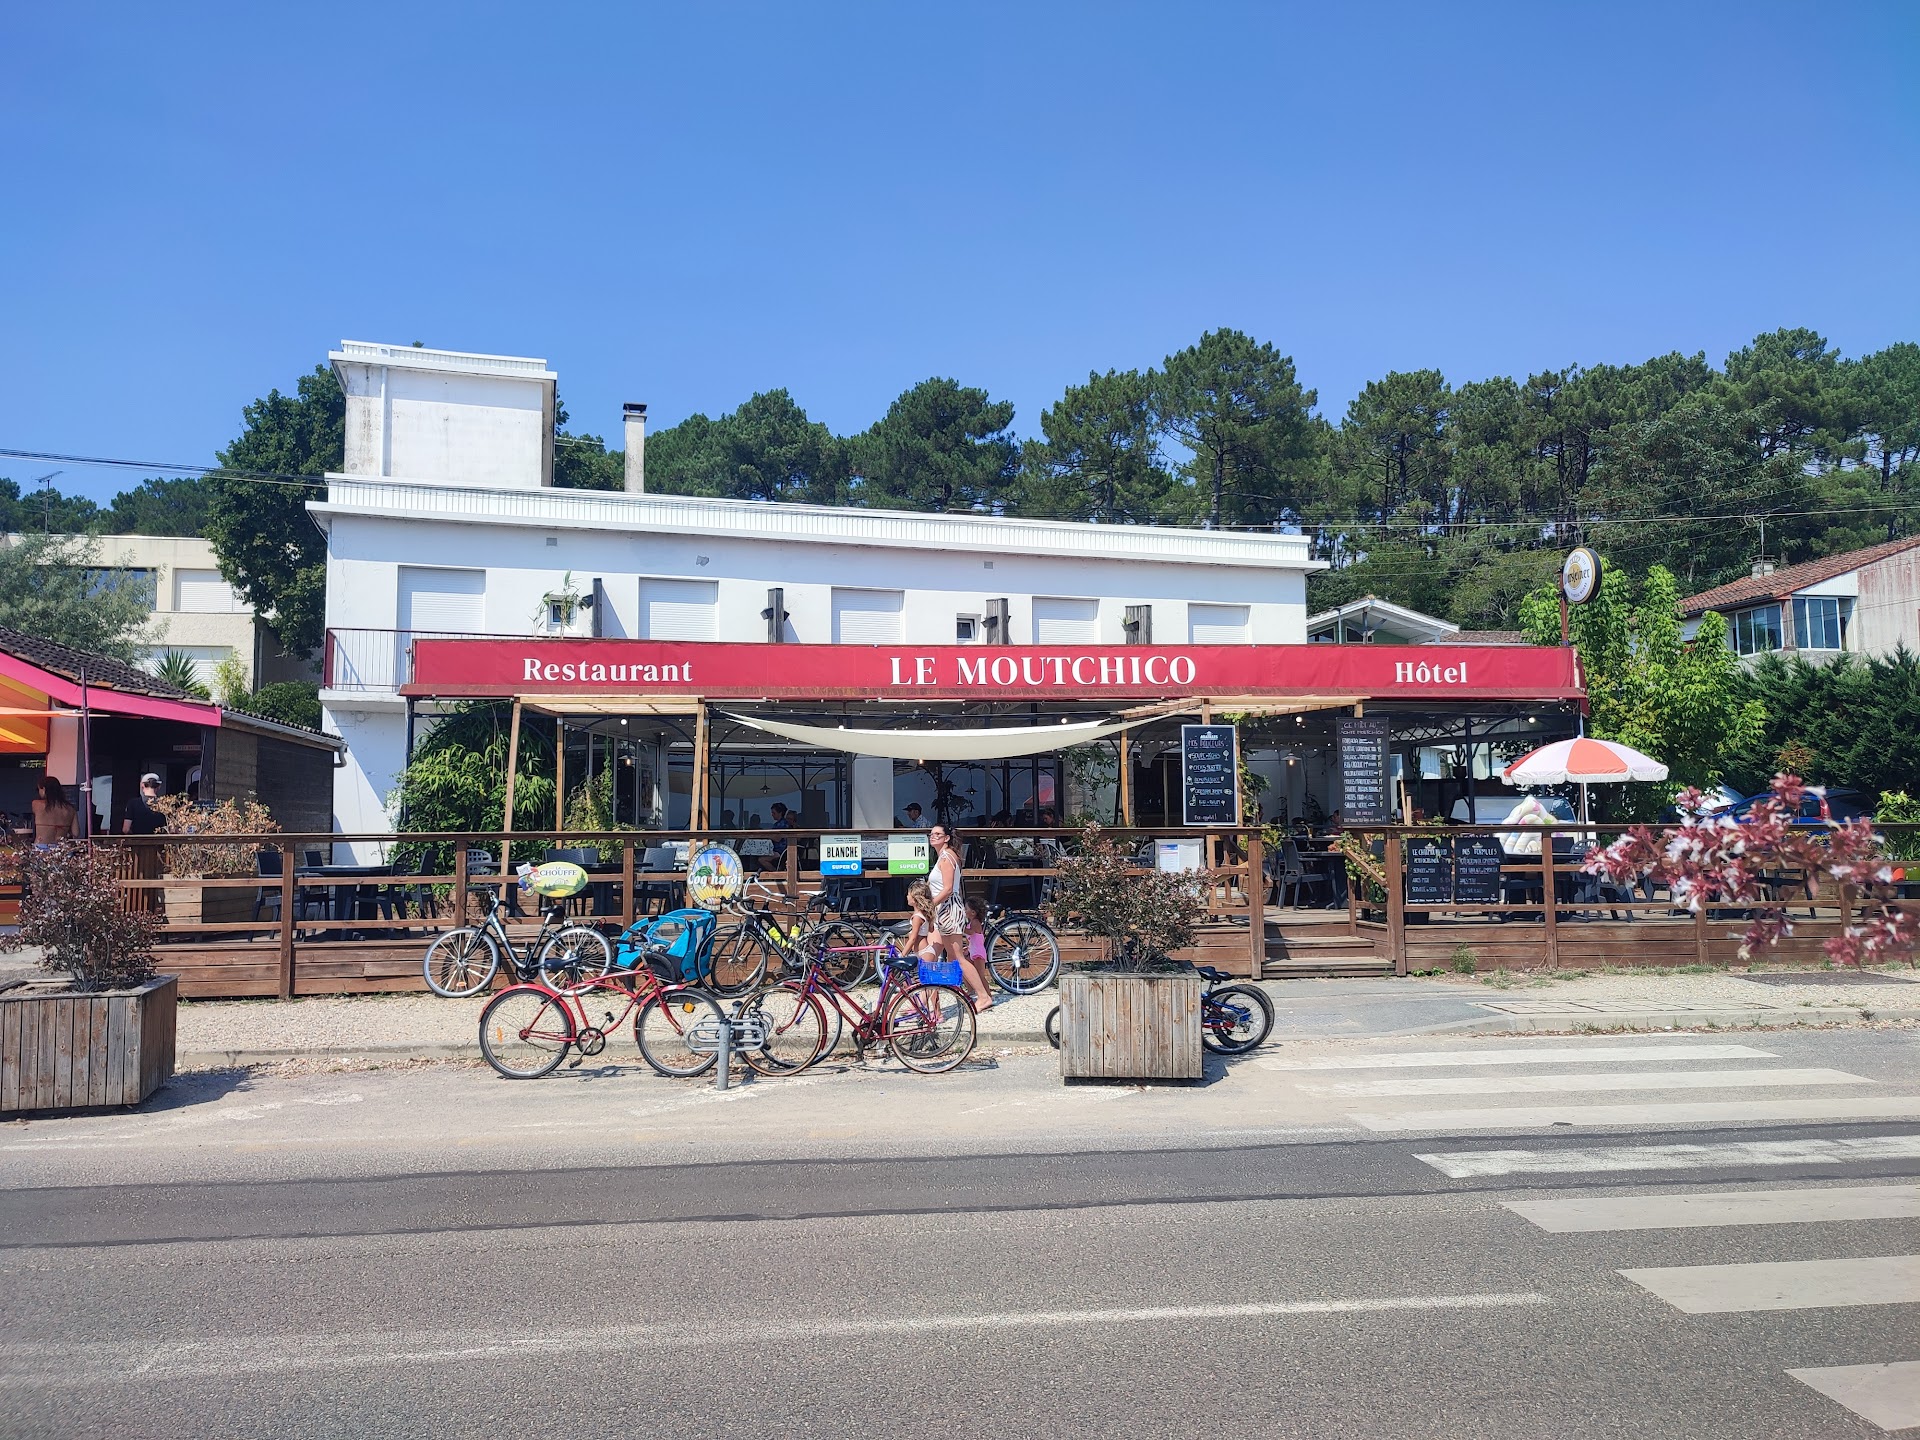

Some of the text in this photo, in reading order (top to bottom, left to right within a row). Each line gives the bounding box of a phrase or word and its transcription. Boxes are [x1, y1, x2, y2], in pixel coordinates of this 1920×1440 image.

[523, 658, 693, 682] Restaurant
[890, 656, 1196, 686] LE MOUTCHICO
[1395, 660, 1468, 684] Hôtel
[826, 846, 858, 858] BLANCHE
[914, 845, 926, 857] IPA
